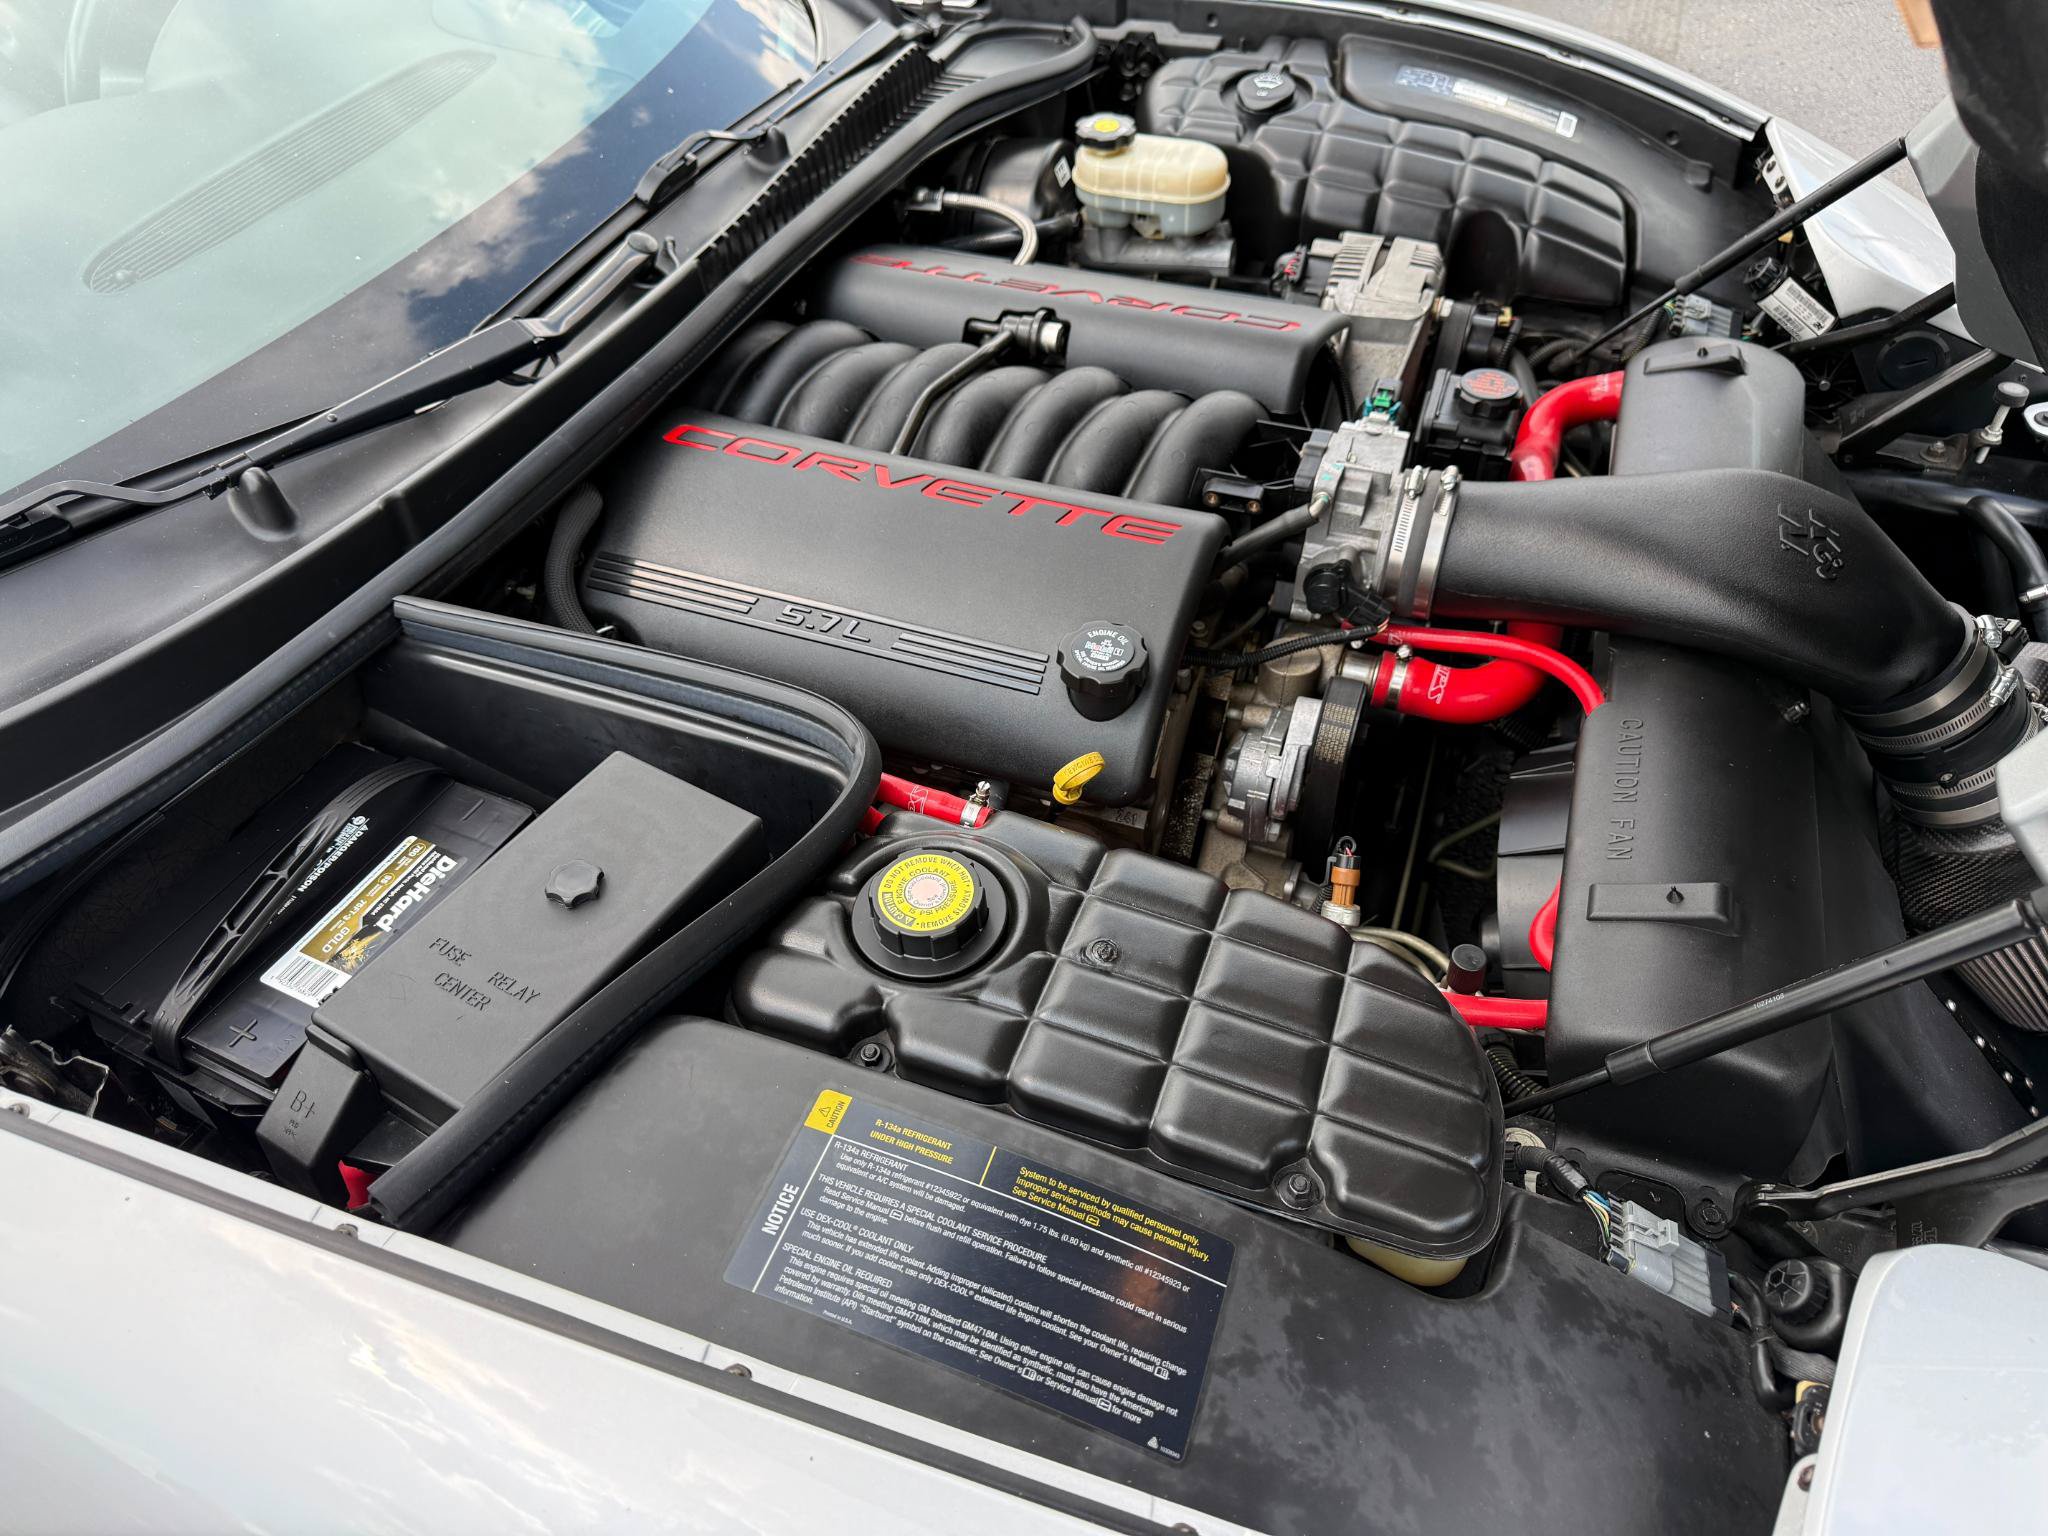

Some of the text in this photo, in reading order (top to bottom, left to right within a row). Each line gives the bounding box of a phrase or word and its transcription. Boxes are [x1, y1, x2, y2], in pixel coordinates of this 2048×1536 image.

[850, 254, 1301, 332] CORVETTE
[662, 424, 1183, 545] CORVETTE
[776, 604, 871, 643] 5.7L
[1087, 629, 1119, 638] ENGINE
[1117, 635, 1129, 645] OIL
[1606, 718, 1644, 861] CAUTION FAN
[297, 829, 364, 892] DANGER/POISON
[884, 856, 970, 889] DO NOT REMOVE WHEN HOT
[377, 854, 458, 932] DieHard
[883, 892, 905, 920] CAUTION
[895, 867, 950, 905] ENGINE COOLANT
[908, 907, 917, 915] 15
[935, 880, 958, 915] PRESSURE
[920, 914, 954, 929] REMOVE
[953, 889, 971, 916] SLOWLY
[321, 926, 351, 954] GOLD
[428, 937, 541, 1004] FUSE RELAY
[434, 972, 492, 1011] CENTER
[290, 1089, 315, 1119] B+
[826, 1101, 845, 1128] CAUTION
[870, 1130, 953, 1164] UNDER HIGH PRESSURE
[875, 1119, 952, 1149] R-134a REFRIGERANT
[834, 1140, 908, 1171] R-134a REFRIGERANT
[836, 1162, 869, 1177] equivalent
[875, 1175, 889, 1184] A/C
[888, 1180, 912, 1192] system
[912, 1188, 925, 1197] will
[924, 1192, 934, 1200] be
[934, 1196, 965, 1212] damaged.
[1012, 1185, 1085, 1220] See Service Manual
[1019, 1166, 1199, 1246] System to be serviced by qualified personnel only.
[761, 1182, 800, 1236] NOTICE
[818, 1173, 1047, 1263] THIS VEHICLE REQUIRES A SPECIAL COOLANT SERVICE PROCEDURE
[819, 1195, 888, 1224] damage to the engine.
[1016, 1176, 1209, 1261] Improper service methods may cause personal injury.
[800, 1207, 816, 1218] USE
[858, 1227, 894, 1245] COOLANT
[893, 1240, 914, 1253] ONLY
[782, 1242, 892, 1288] SPECIAL ENGINE OIL REQUIRED
[823, 1185, 1187, 1333] Read Service Manual before flush and refill operation. Failure to follow special procedure could result in serious
[774, 1284, 812, 1304] information.
[801, 1230, 821, 1241] much
[820, 1237, 844, 1250] sooner.
[844, 1244, 852, 1252] If
[850, 1248, 864, 1257] you
[864, 1252, 878, 1262] add
[878, 1257, 903, 1272] coolant,
[904, 1267, 918, 1277] use
[918, 1272, 933, 1283] only
[974, 1294, 1005, 1310] extended
[1005, 1304, 1017, 1315] life
[1017, 1309, 1041, 1324] engine
[1041, 1320, 1067, 1336] coolant.
[1068, 1330, 1082, 1342] See
[1082, 1337, 1099, 1348] your
[1099, 1343, 1128, 1361] Owner's
[1128, 1355, 1154, 1372] Manual
[789, 1255, 1178, 1416] This engine requires special oil meeting GM Standard GM4718M. Using other engine oils can cause engine damage not
